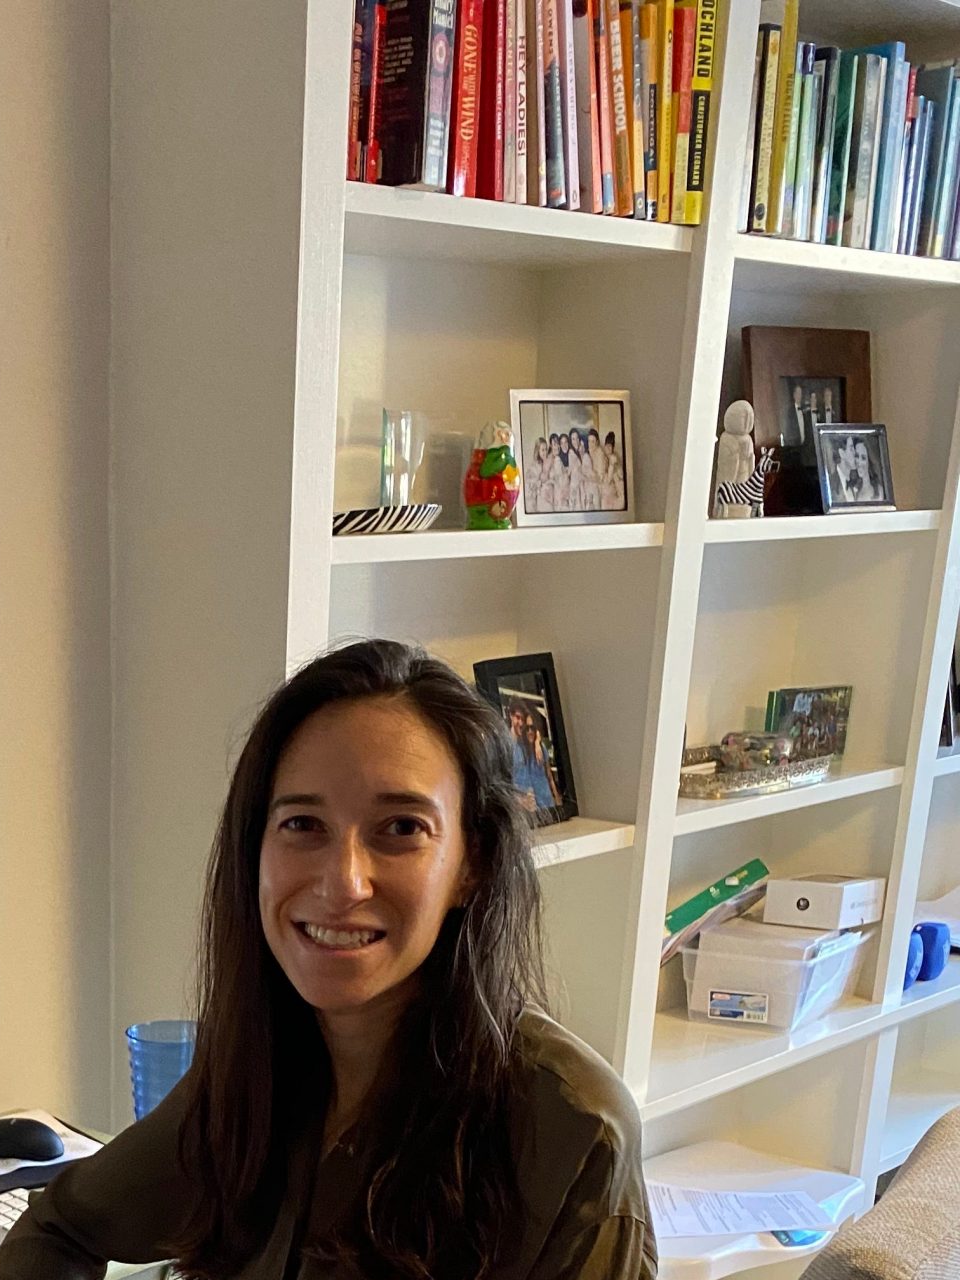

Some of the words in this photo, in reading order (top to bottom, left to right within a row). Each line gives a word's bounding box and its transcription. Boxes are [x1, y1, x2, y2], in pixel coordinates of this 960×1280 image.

[463, 24, 478, 75] GONE
[517, 36, 526, 76] HEY
[609, 19, 623, 71] BEER
[633, 15, 641, 107] CICERO
[460, 96, 476, 141] WIND
[517, 81, 526, 157] LADIES!
[613, 73, 627, 135] SCHOOL
[693, 95, 706, 150] CHRISTOPHER
[691, 151, 703, 187] LEONARD
